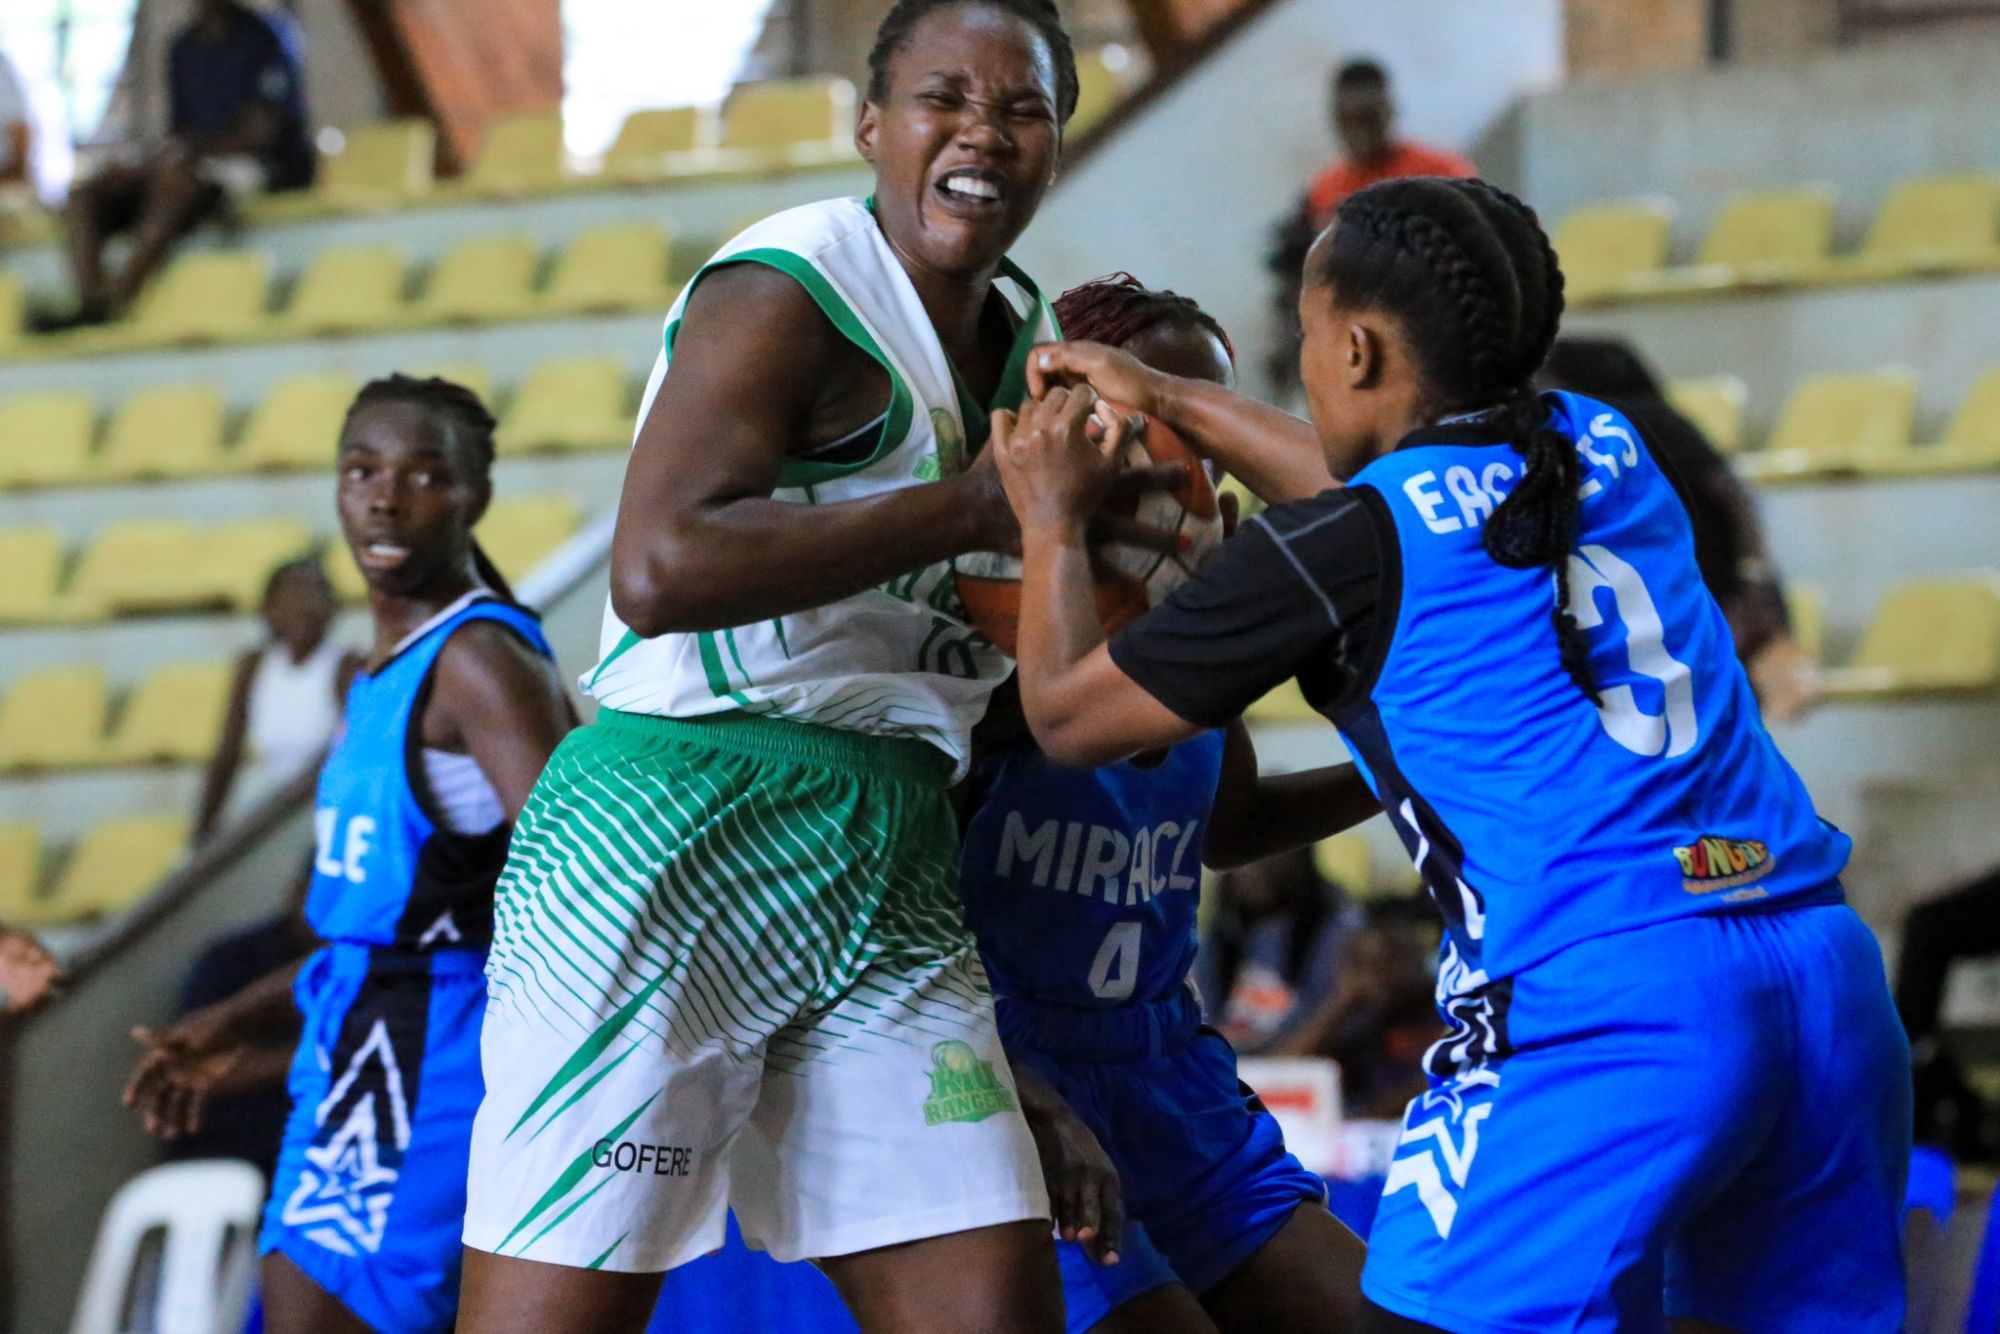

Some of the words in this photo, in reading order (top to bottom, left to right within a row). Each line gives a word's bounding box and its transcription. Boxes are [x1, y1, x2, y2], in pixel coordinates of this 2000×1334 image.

[1553, 544, 1698, 759] 3
[1087, 922, 1143, 998] 4
[592, 1138, 692, 1176] GOFERE
